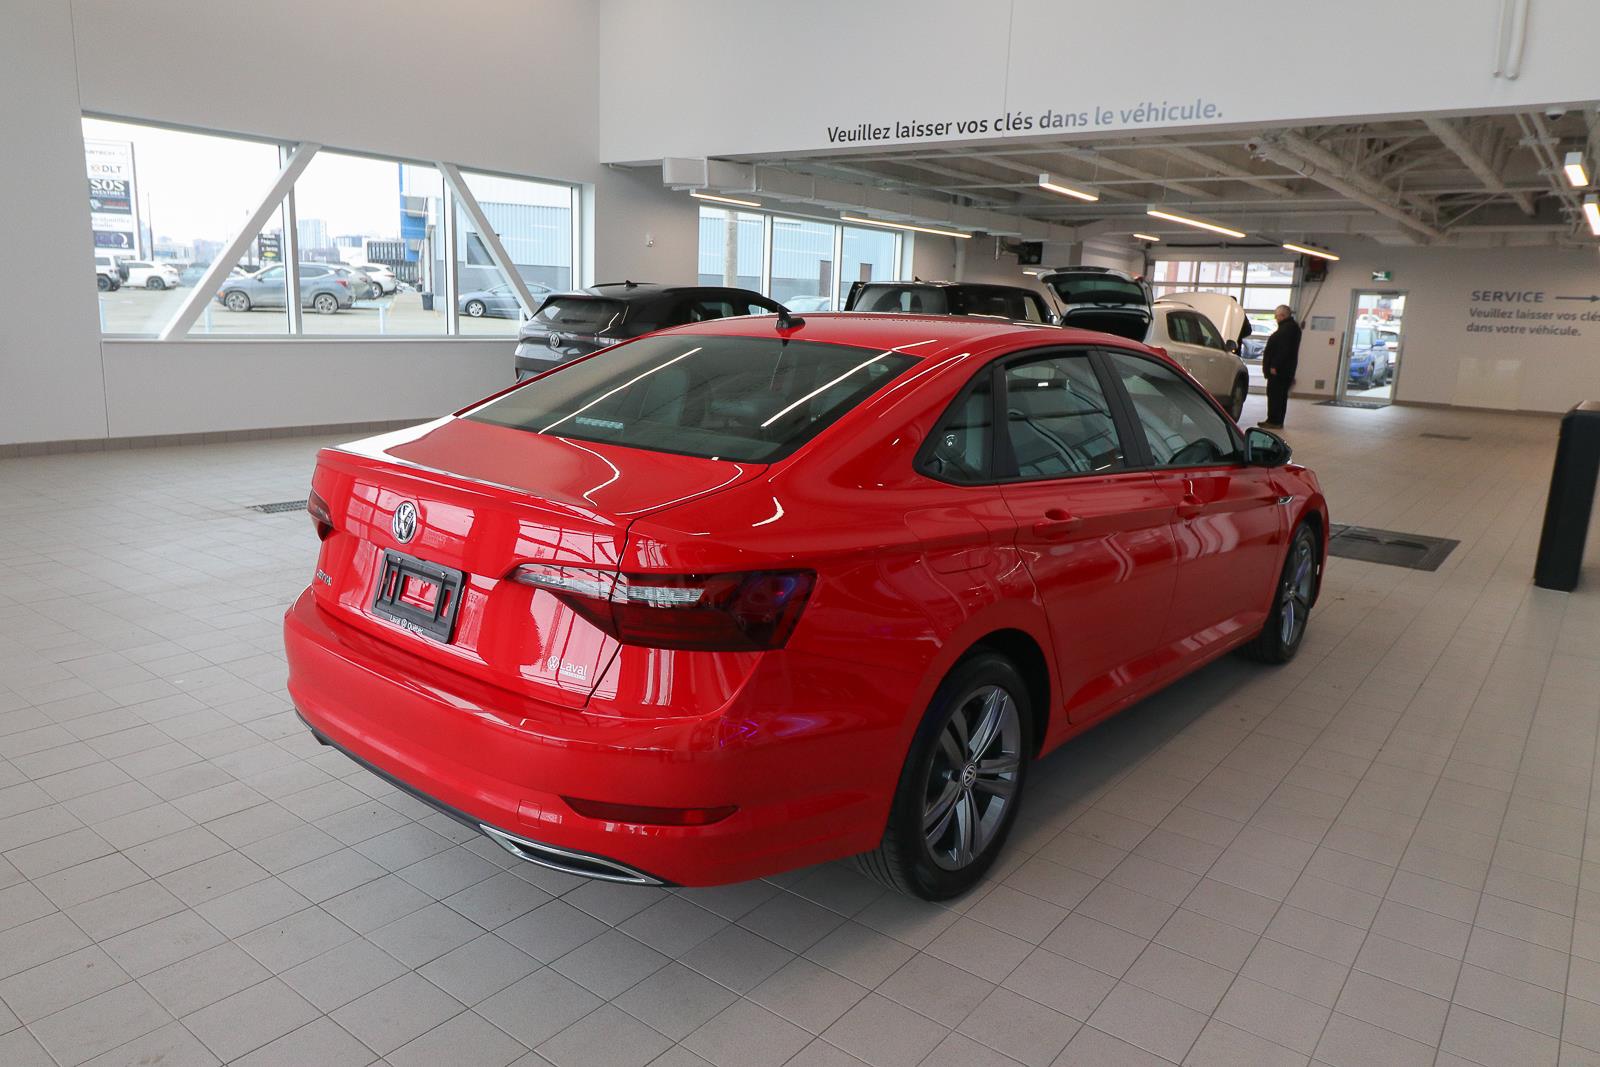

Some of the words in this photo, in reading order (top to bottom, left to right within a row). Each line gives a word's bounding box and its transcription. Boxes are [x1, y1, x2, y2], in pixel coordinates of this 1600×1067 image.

[827, 124, 891, 143] Veuillez
[895, 120, 952, 139] laisser
[957, 118, 988, 134] vos
[993, 111, 1033, 132] clés
[1039, 109, 1088, 129] dans
[1094, 106, 1114, 126] le
[1120, 98, 1223, 124] véhicule.
[102, 164, 122, 174] DLT
[90, 178, 125, 192] SOS
[1471, 290, 1545, 303] SERVICE
[1469, 307, 1513, 319] Veuillez
[1516, 309, 1554, 320] laisser
[1556, 312, 1577, 321] vos
[1466, 322, 1493, 333] dans
[1495, 324, 1525, 335] votre
[1529, 324, 1582, 337] véhicule.
[560, 658, 588, 677] Laval
